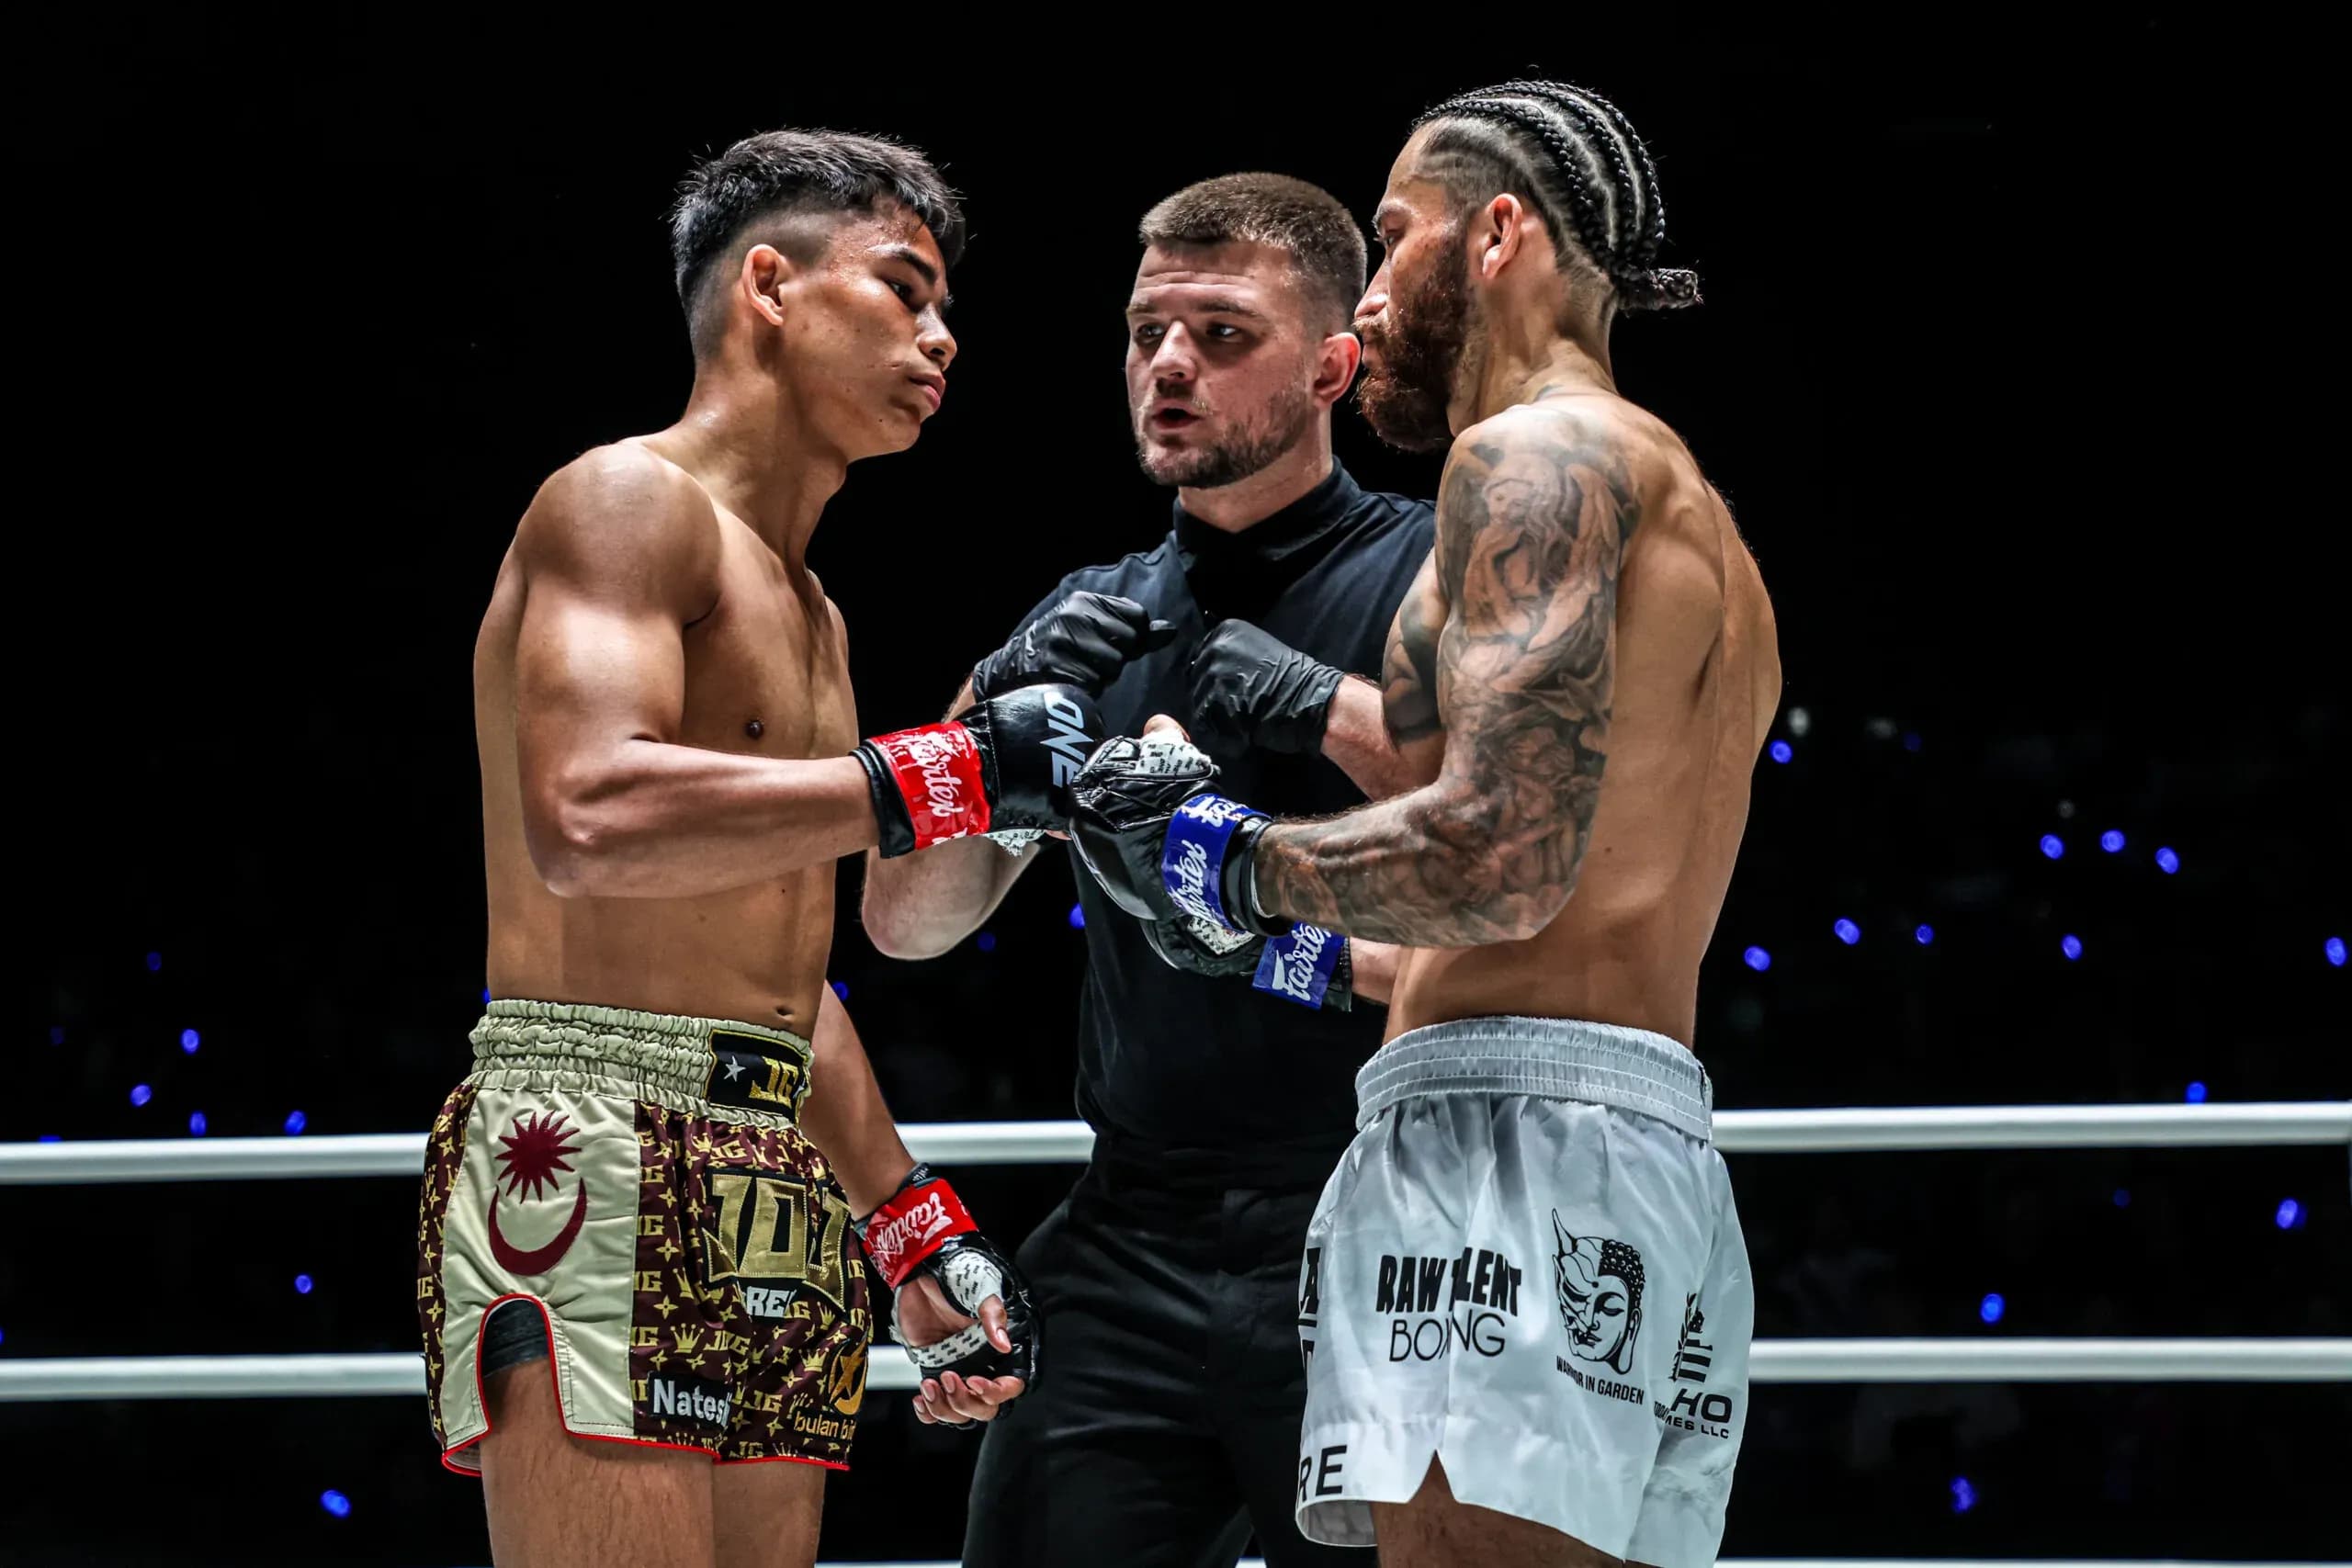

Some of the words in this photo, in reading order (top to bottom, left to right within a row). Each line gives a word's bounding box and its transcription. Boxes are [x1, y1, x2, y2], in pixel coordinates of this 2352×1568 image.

[1040, 692, 1095, 788] ONE
[1375, 1255, 1447, 1314] RAW
[1586, 1374, 1597, 1393] IN
[1598, 1378, 1645, 1406] GARDEN
[794, 1410, 840, 1438] bulan
[1701, 1425, 1730, 1439] LLC
